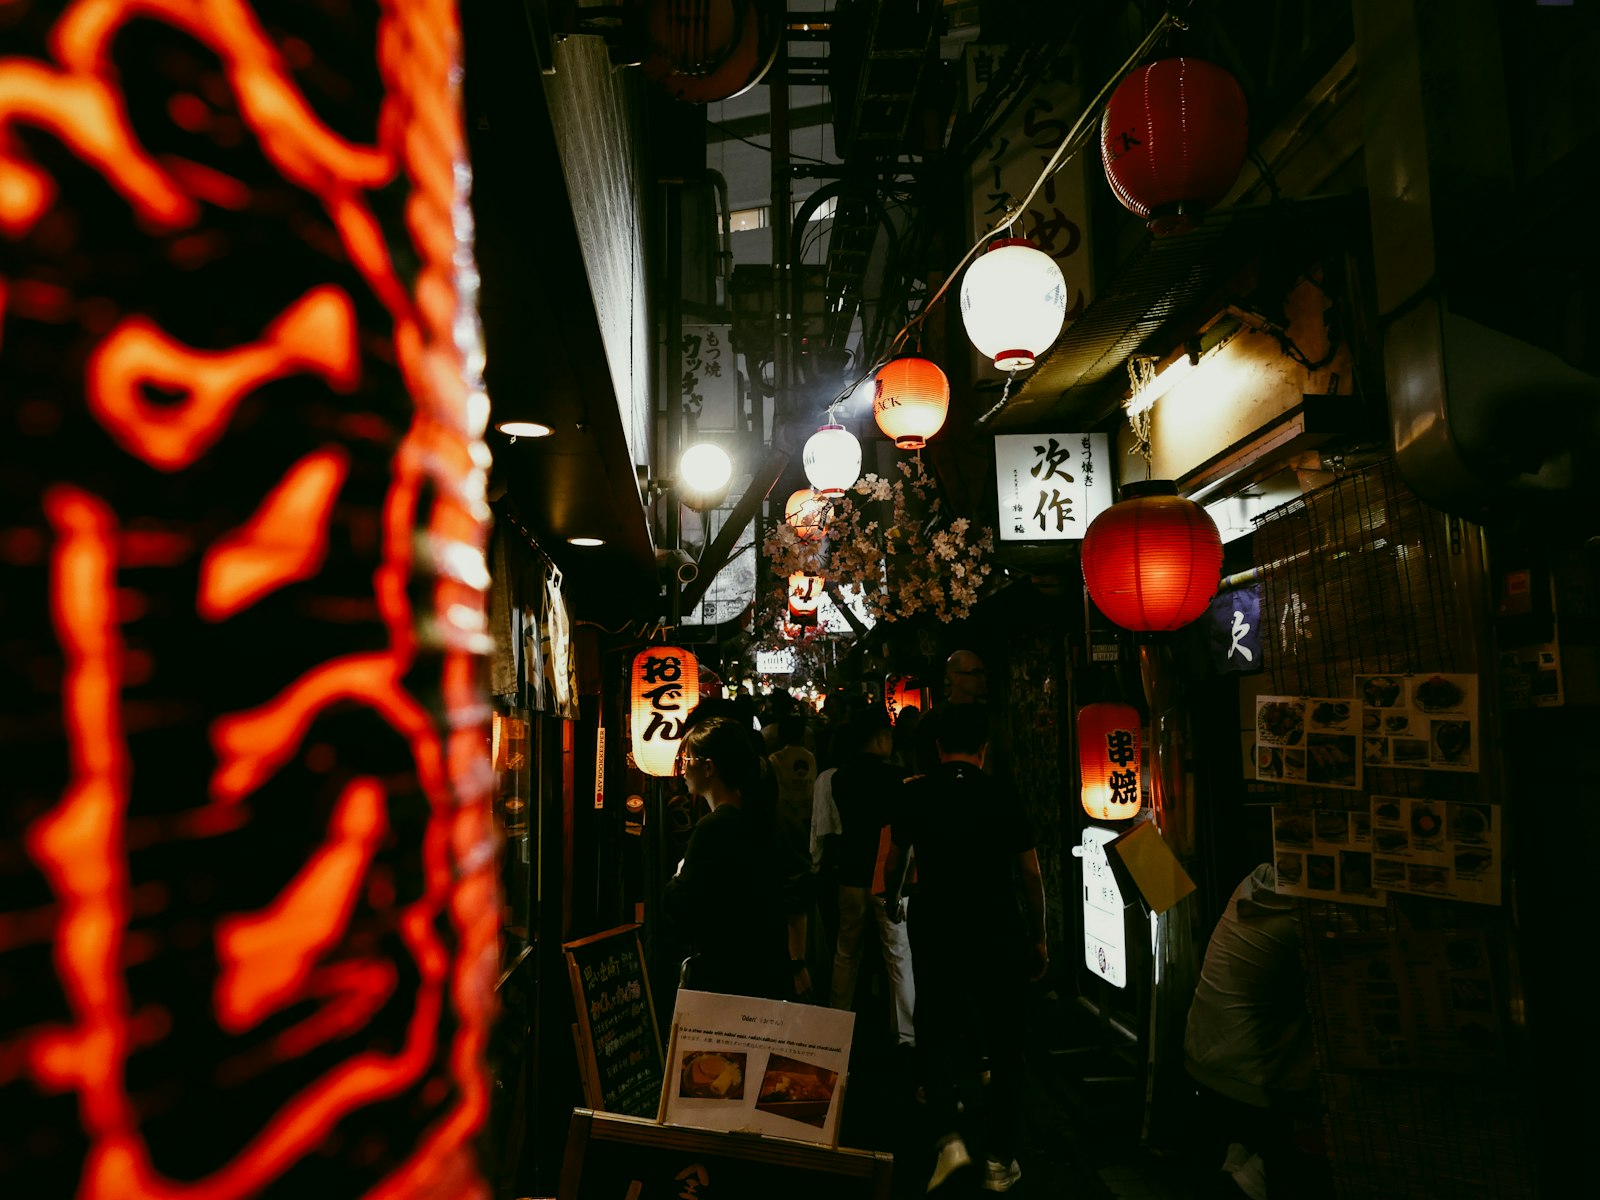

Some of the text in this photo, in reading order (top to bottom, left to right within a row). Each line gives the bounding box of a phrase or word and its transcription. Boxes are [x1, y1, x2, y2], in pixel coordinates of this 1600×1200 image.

[705, 331, 721, 378] もつ焼
[1030, 438, 1076, 532] 次作
[1081, 437, 1094, 487] もつ焼き
[641, 656, 683, 741] おでん
[1107, 730, 1137, 804] 串焼
